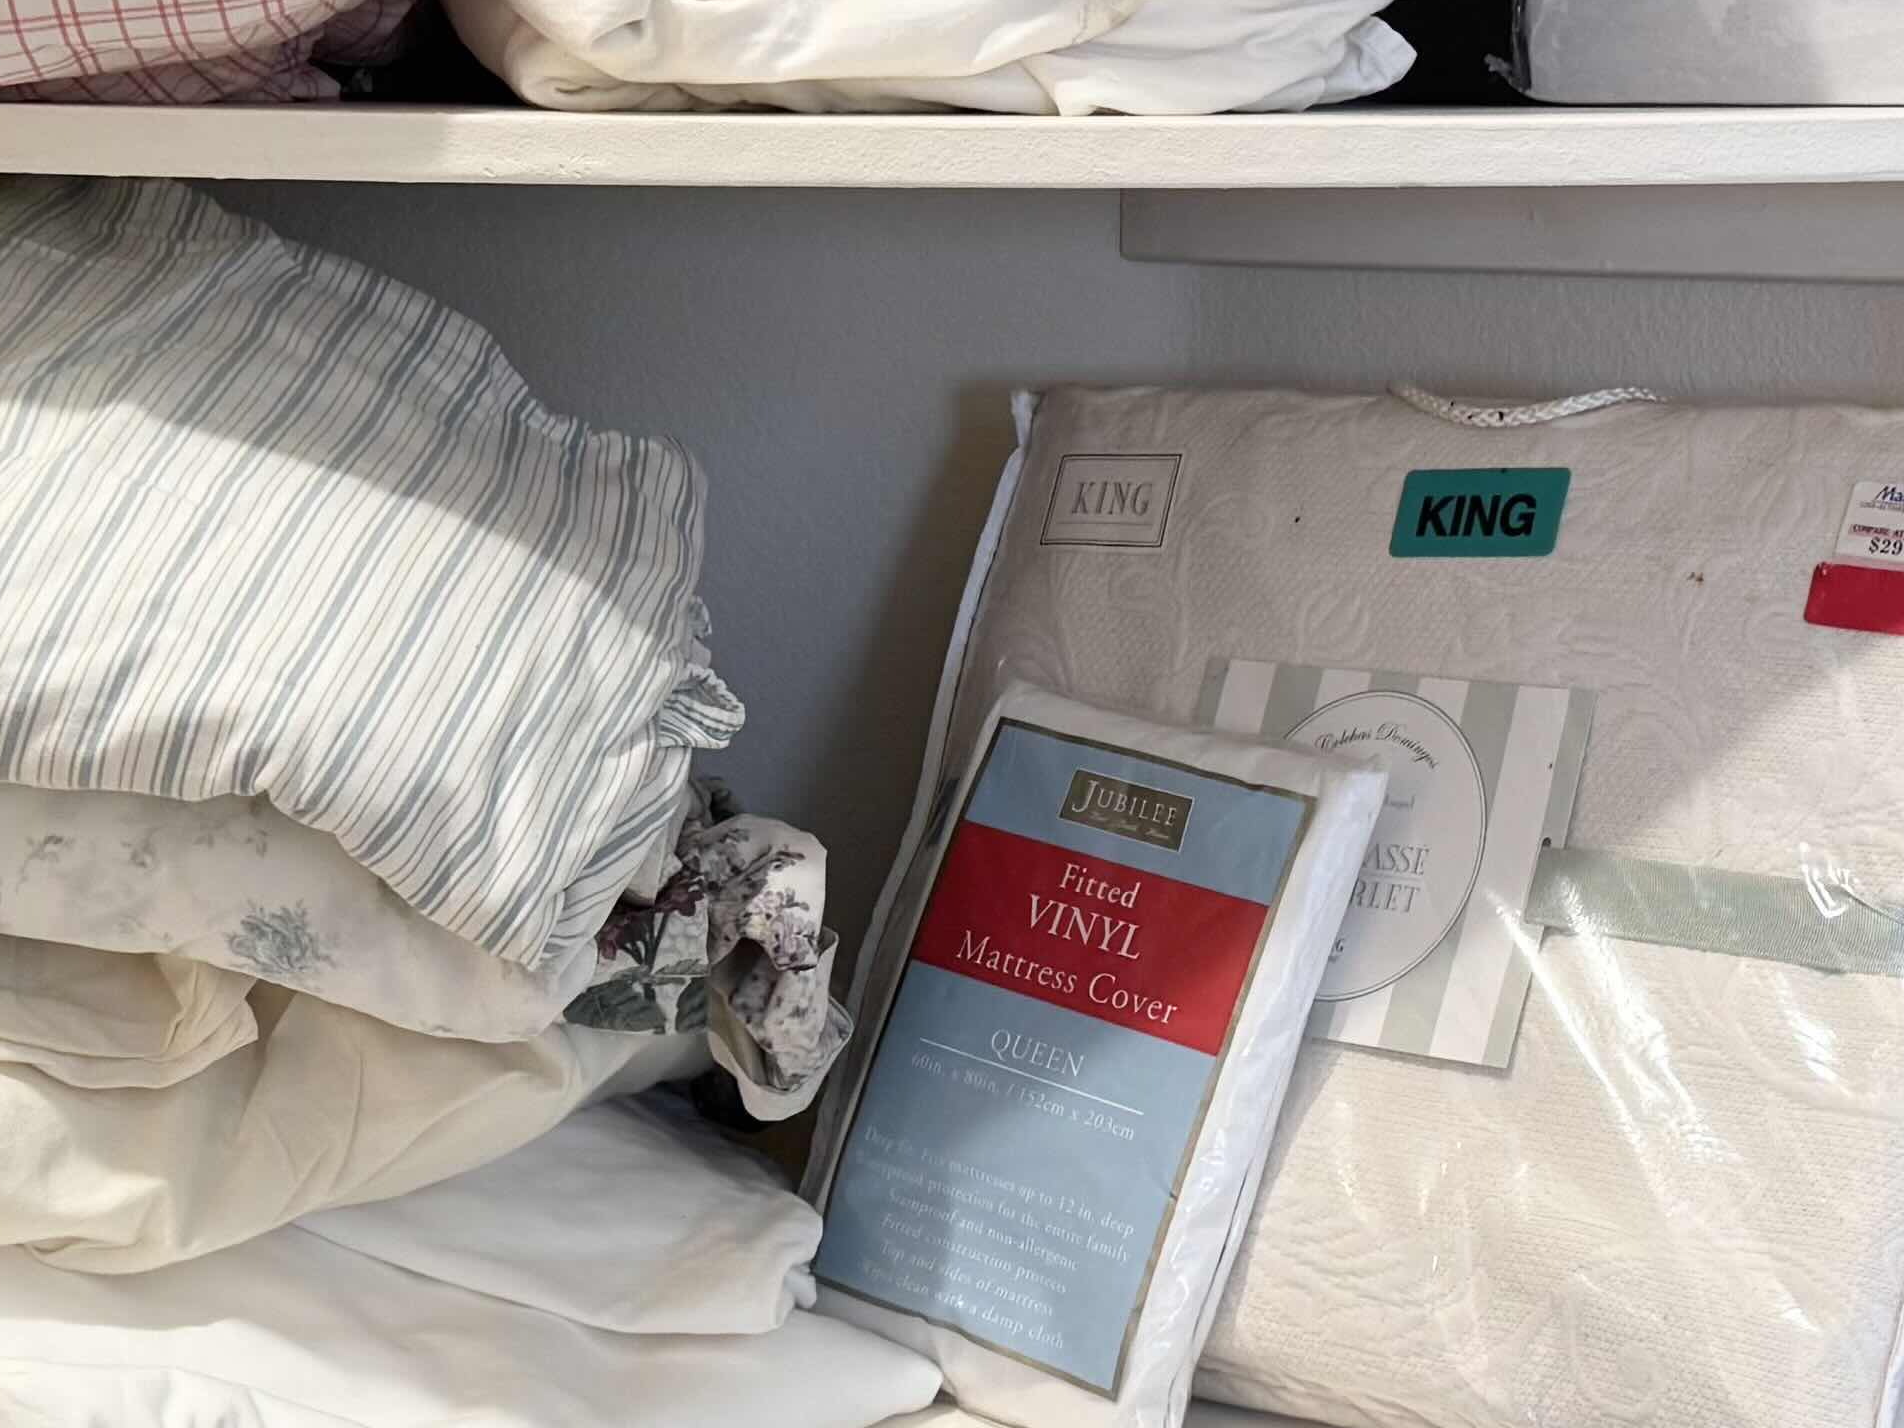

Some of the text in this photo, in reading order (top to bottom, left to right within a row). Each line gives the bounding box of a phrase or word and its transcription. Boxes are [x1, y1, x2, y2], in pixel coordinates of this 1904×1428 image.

[1071, 481, 1153, 517] KING
[1415, 493, 1537, 537] KING
[1853, 523, 1891, 536] COMPARE
[1894, 530, 1904, 538] AT
[1059, 862, 1141, 909] Fitted
[1350, 880, 1421, 913] RLET
[1028, 893, 1141, 960] VINYL
[956, 930, 1178, 1025] Mattress Cover
[991, 1028, 1085, 1077] QUEEN
[1019, 1085, 1065, 1116] 152cm
[1084, 1109, 1135, 1141] 203cm
[960, 1217, 984, 1236] and
[998, 1200, 1016, 1220] for
[1020, 1211, 1038, 1229] the
[1044, 1223, 1083, 1245] entire
[1086, 1234, 1128, 1267] family
[1016, 1186, 1036, 1205] up
[1039, 1192, 1053, 1205] to
[1058, 1195, 1076, 1214] 12
[1100, 1211, 1135, 1239] deep
[996, 1285, 1054, 1317] mattress
[982, 1308, 1024, 1334] damp
[1028, 1324, 1064, 1349] cloth
